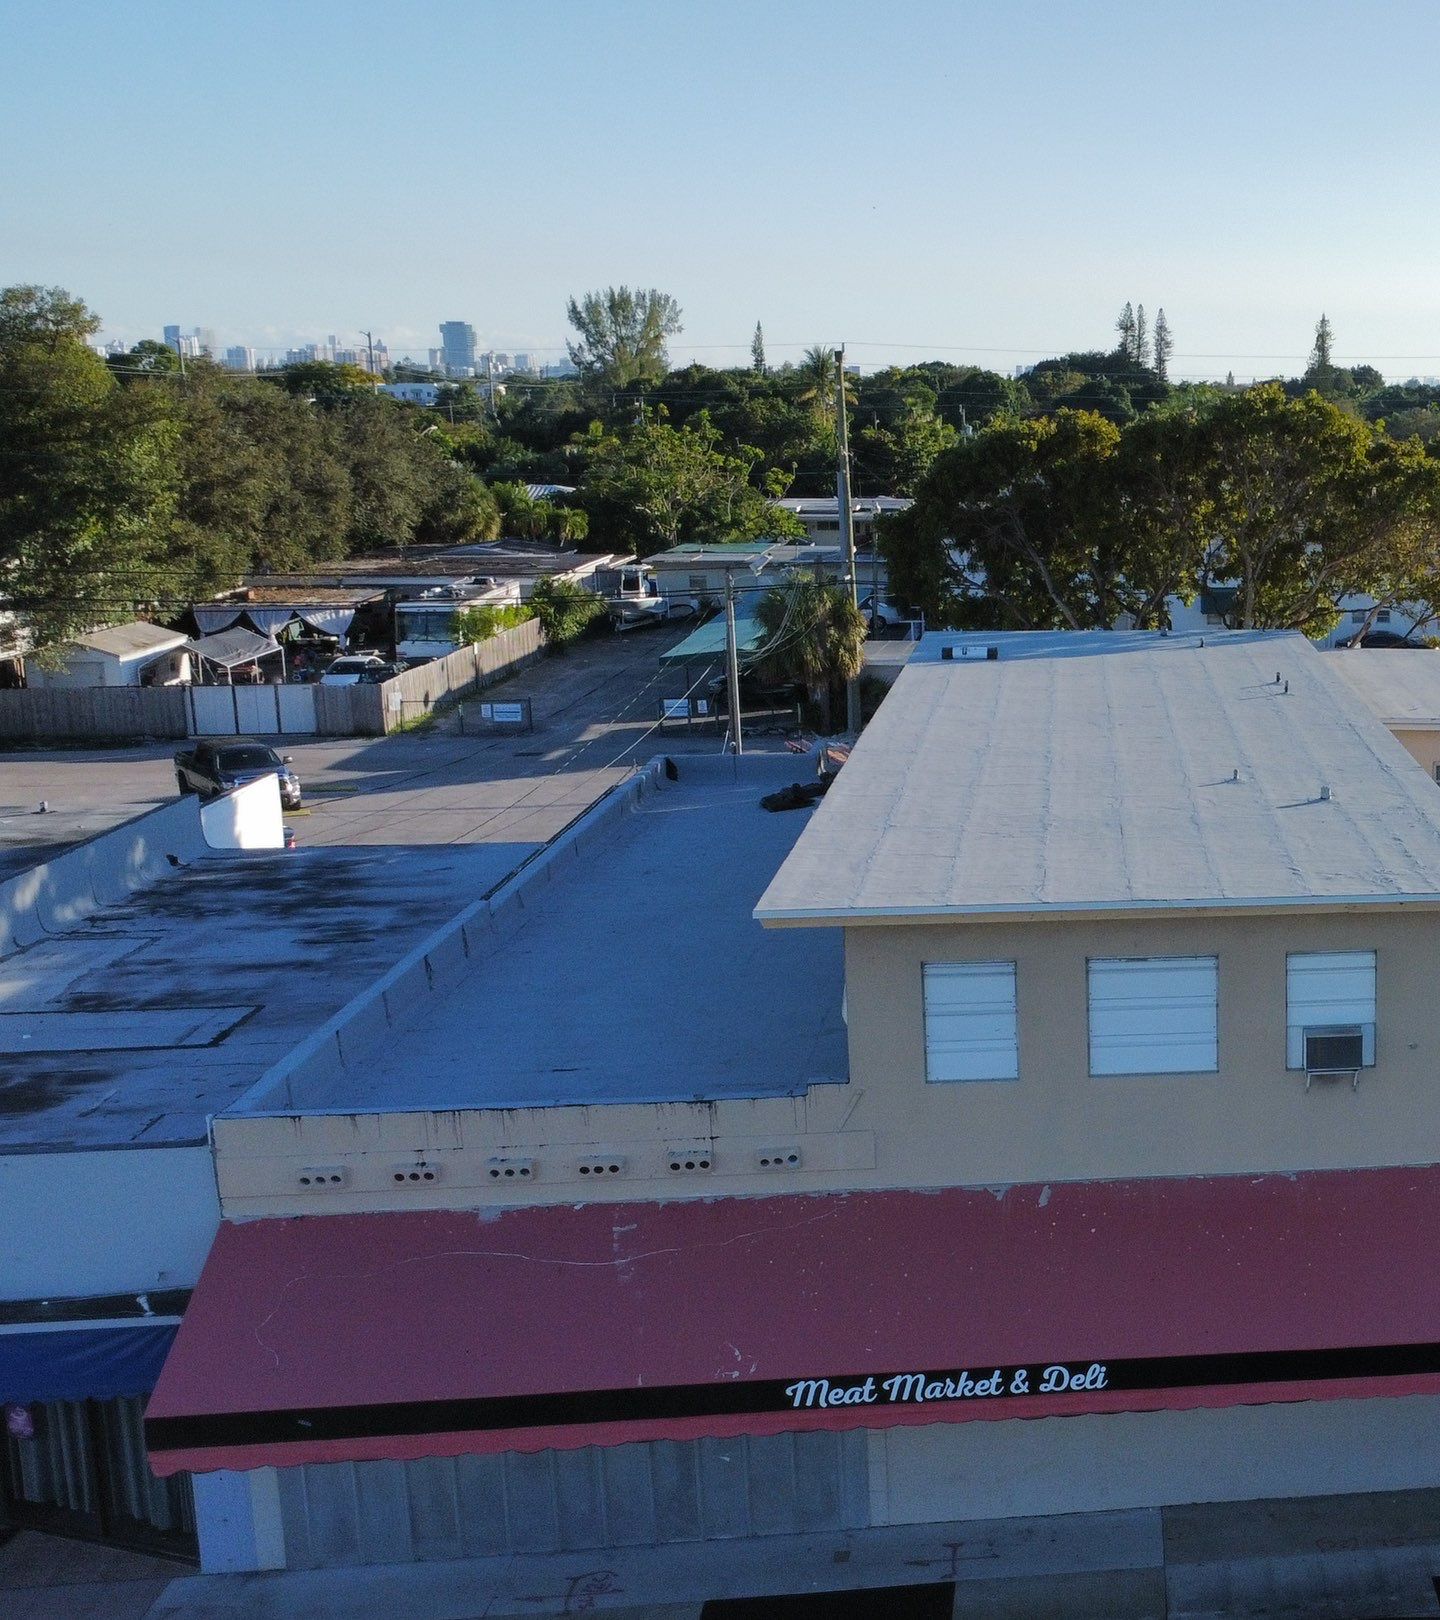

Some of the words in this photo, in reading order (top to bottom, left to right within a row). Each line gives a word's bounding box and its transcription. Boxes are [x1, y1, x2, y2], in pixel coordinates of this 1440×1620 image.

[785, 1377, 877, 1408] Meat
[882, 1371, 1004, 1403] Market
[1010, 1368, 1029, 1394] &
[1038, 1363, 1108, 1392] Deli
